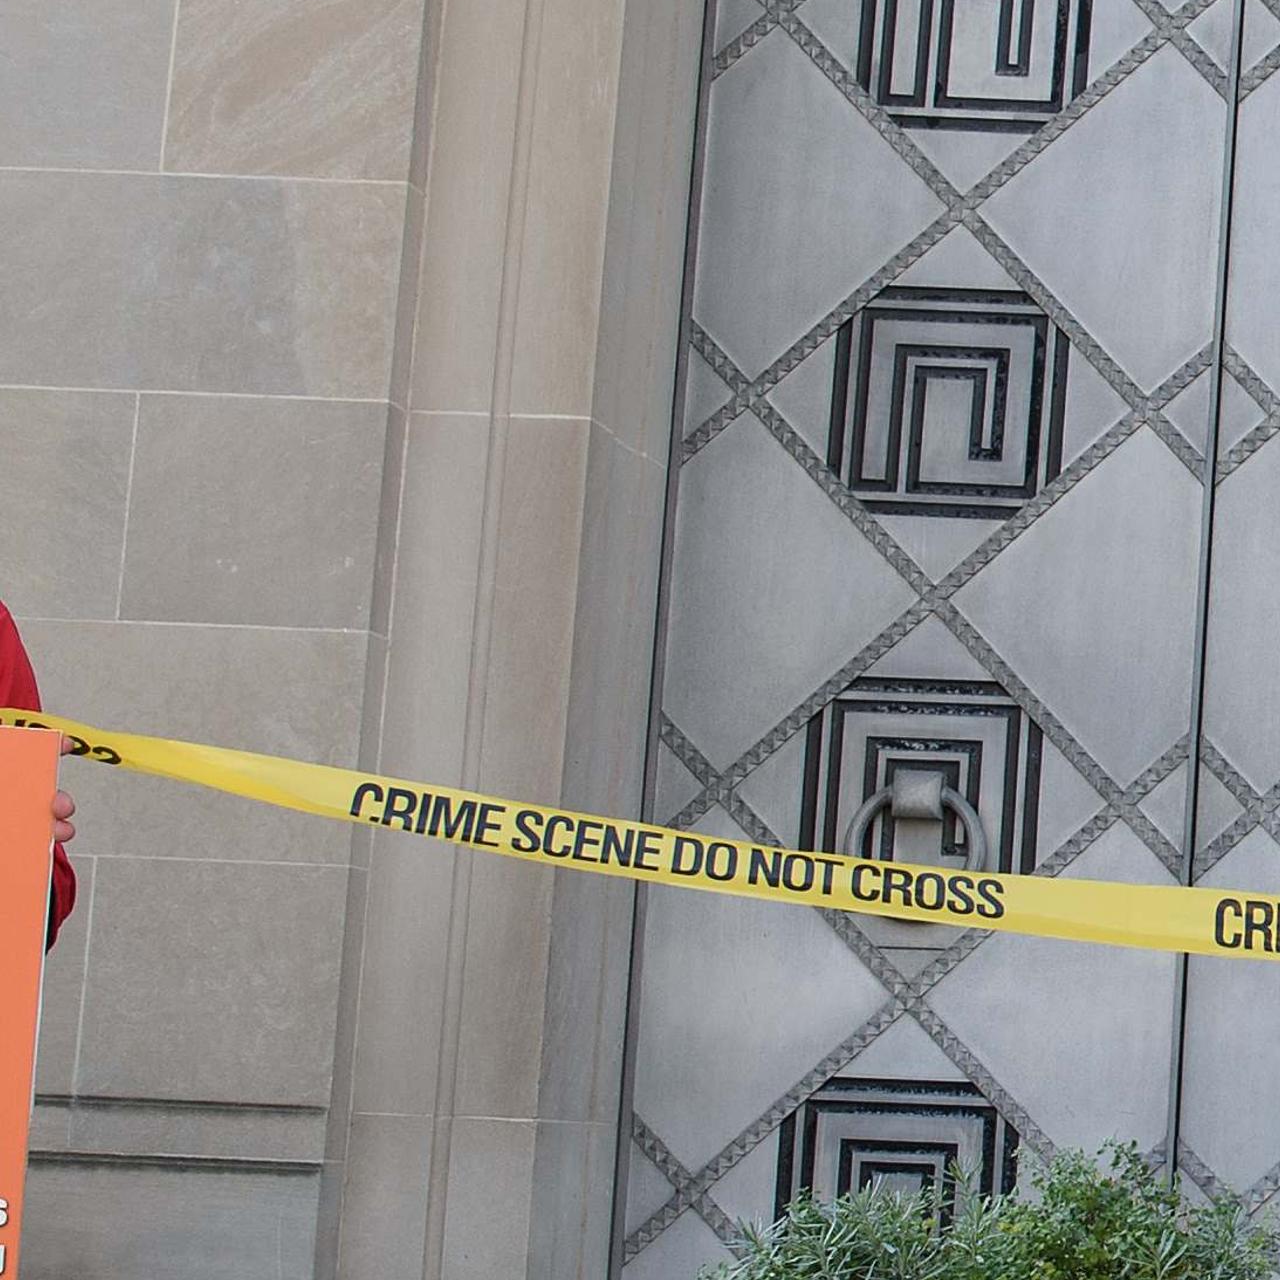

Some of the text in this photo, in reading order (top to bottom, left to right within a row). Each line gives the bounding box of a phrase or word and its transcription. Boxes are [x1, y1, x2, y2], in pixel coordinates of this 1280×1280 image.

[350, 782, 1004, 919] CRIME SCENE DO NOT CROSS
